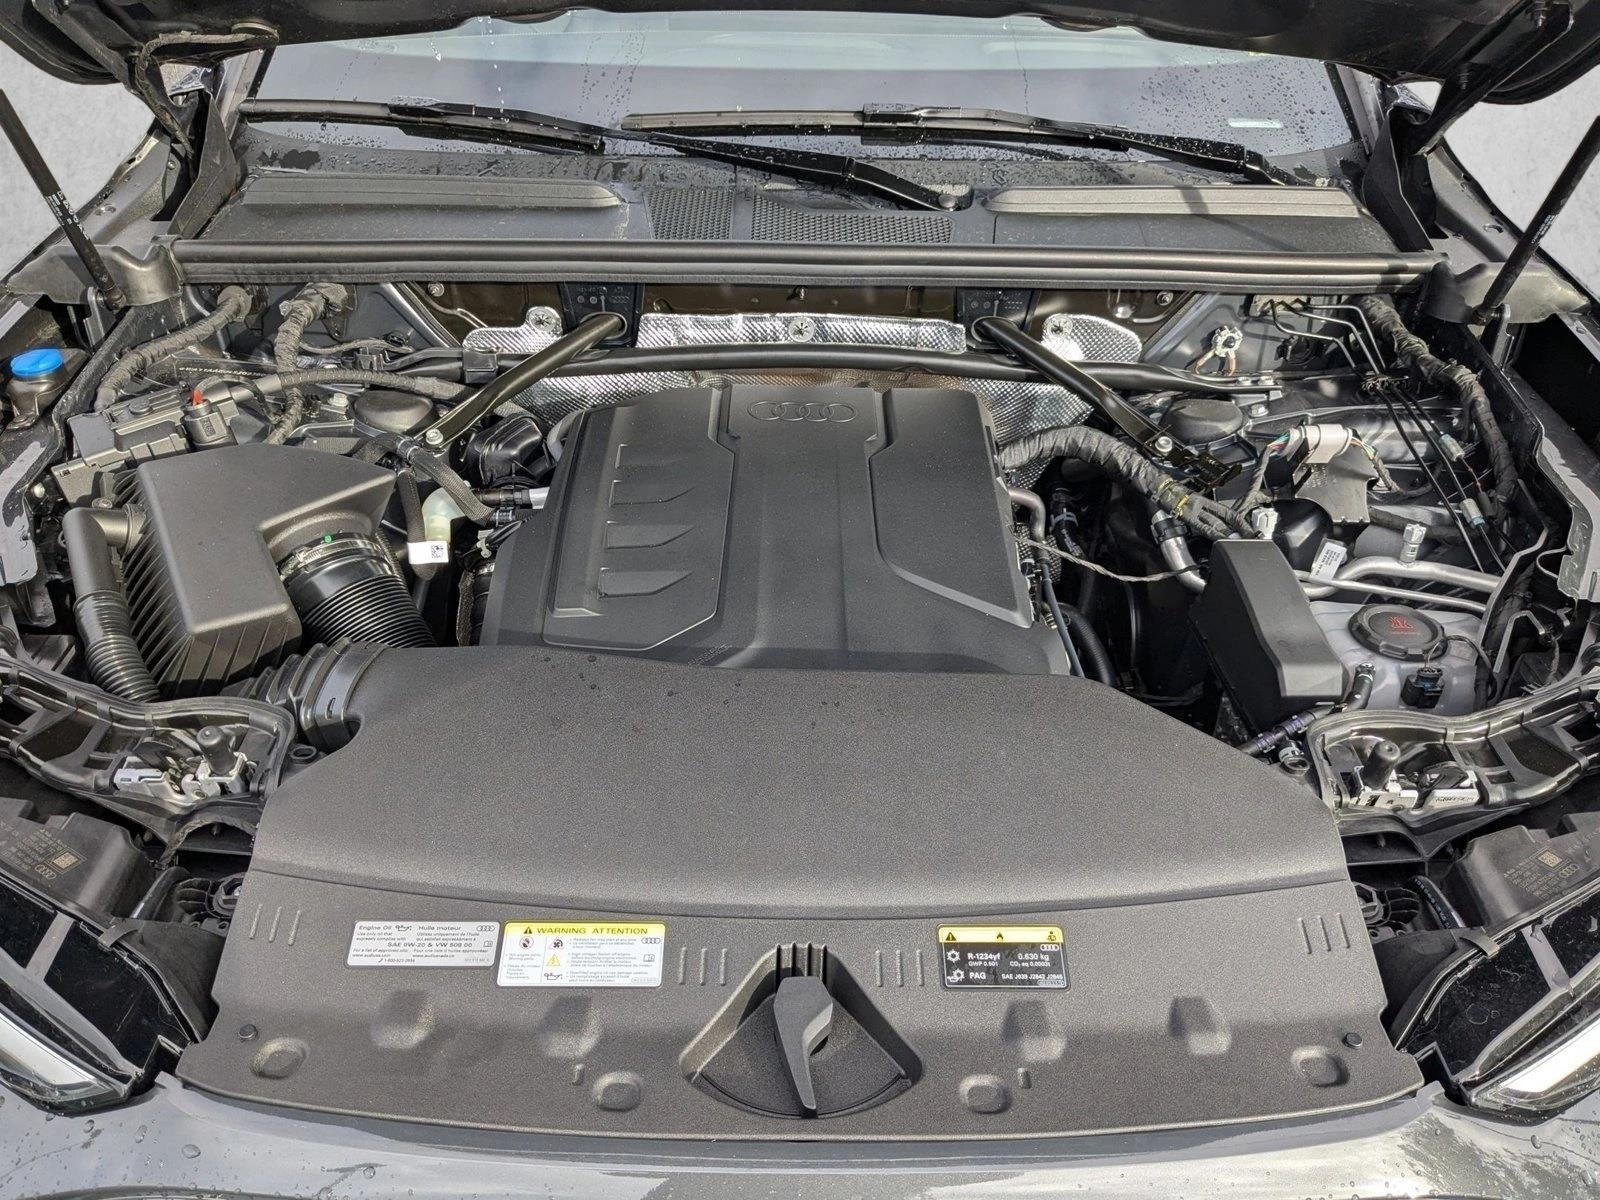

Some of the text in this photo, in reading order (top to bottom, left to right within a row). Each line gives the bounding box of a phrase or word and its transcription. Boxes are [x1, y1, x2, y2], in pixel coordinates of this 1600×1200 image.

[967, 952, 1049, 961] R-1234yf 0.630 kg
[969, 972, 986, 980] PAG
